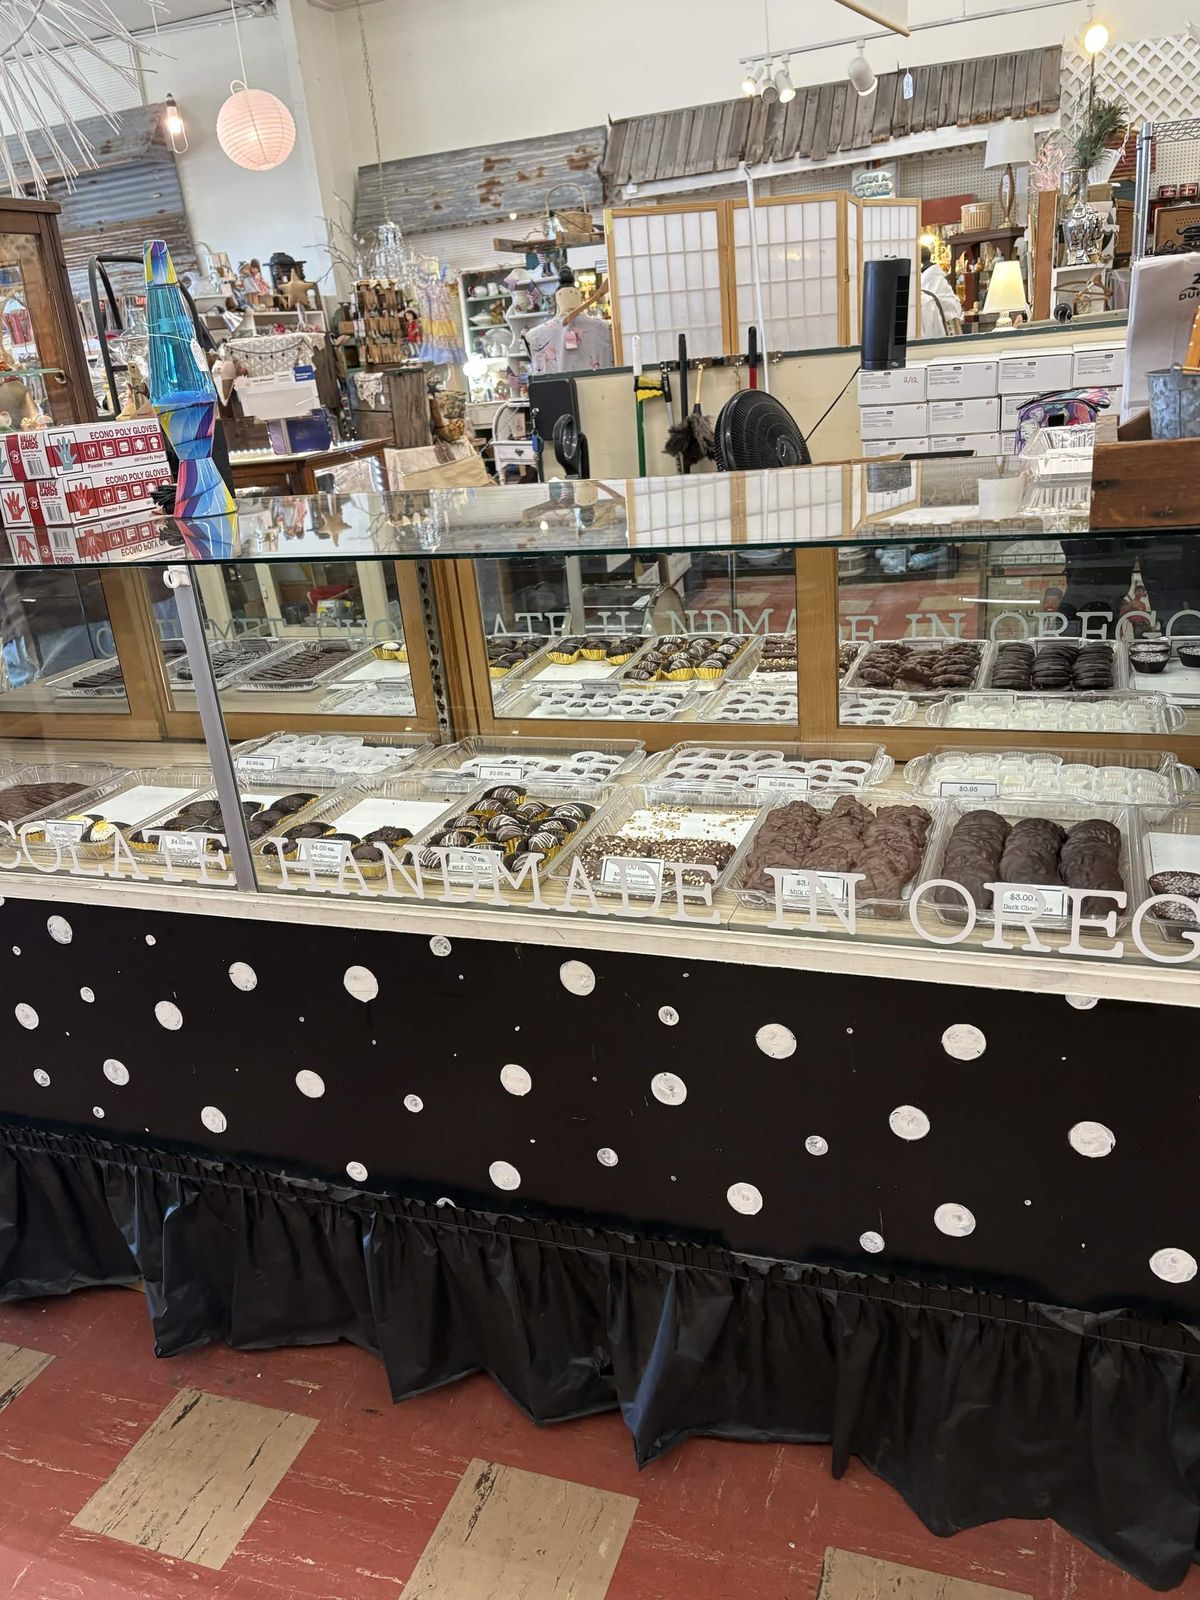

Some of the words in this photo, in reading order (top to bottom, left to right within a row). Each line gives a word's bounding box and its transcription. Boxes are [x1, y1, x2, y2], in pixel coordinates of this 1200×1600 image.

[89, 429, 114, 440] ECONO
[115, 426, 133, 437] POLY
[133, 424, 158, 434] GLOVES
[88, 461, 103, 469] Powder
[105, 474, 129, 485] ECONO
[129, 471, 145, 481] POLY
[145, 467, 169, 478] GLOVES
[905, 612, 967, 641] IN
[267, 836, 721, 925] HANDMADE
[763, 867, 867, 935] IN
[1010, 893, 1034, 902] $3.00
[1003, 903, 1019, 911] Dark
